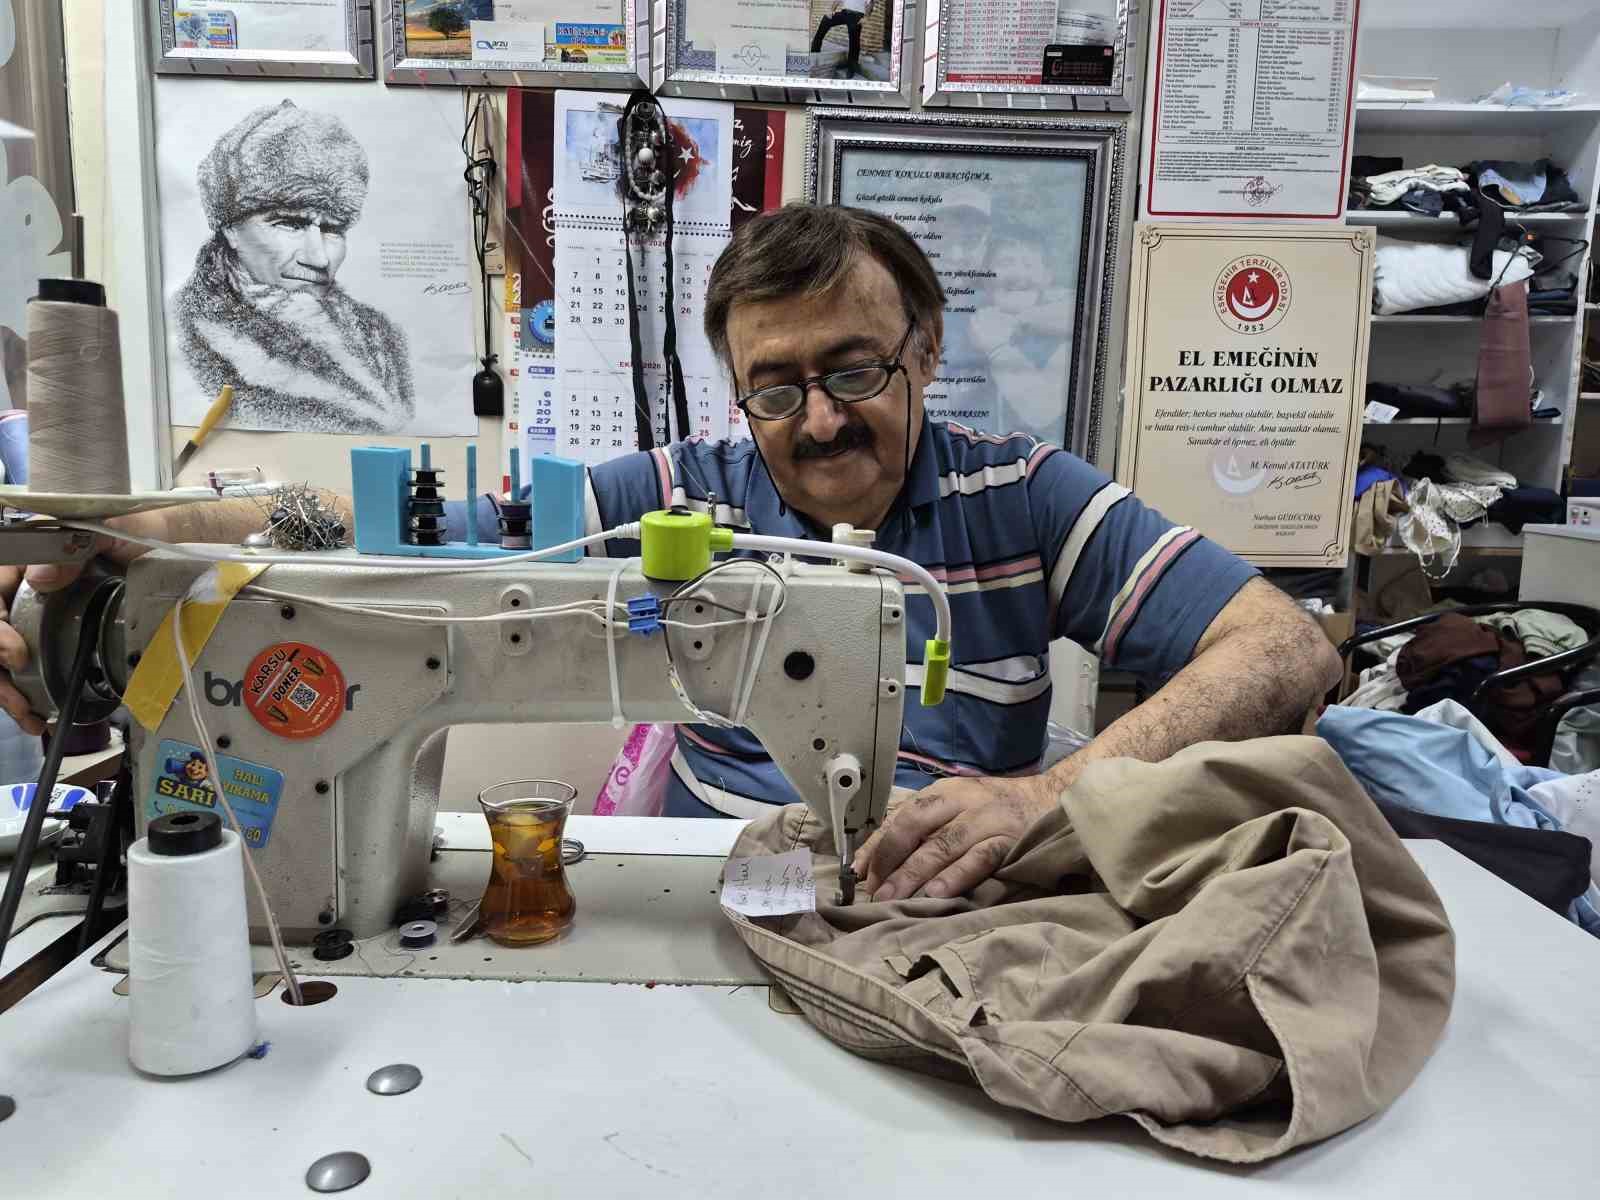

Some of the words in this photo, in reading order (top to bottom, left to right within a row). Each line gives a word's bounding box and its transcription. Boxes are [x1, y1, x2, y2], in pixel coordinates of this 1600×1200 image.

[592, 317, 603, 325] 29
[615, 318, 625, 326] 30
[1238, 323, 1264, 332] 1952
[1178, 350, 1205, 367] EL
[1213, 347, 1319, 368] EMEĞİNİN
[1149, 373, 1263, 393] PAZARLIĞI
[1271, 377, 1344, 394] OLMAZ
[538, 399, 551, 407] 13
[570, 409, 580, 417] 12
[1193, 409, 1217, 418] herkes
[1219, 410, 1243, 418] mebus
[1276, 410, 1306, 420] başvekil
[536, 417, 551, 425] 27
[570, 423, 580, 431] 19
[1154, 423, 1174, 431] hatta
[1197, 424, 1227, 432] cumhur
[590, 438, 600, 446] 27
[1263, 461, 1286, 469] Kemal
[1287, 461, 1329, 470] ATATÜRK
[250, 649, 288, 694] KARSU
